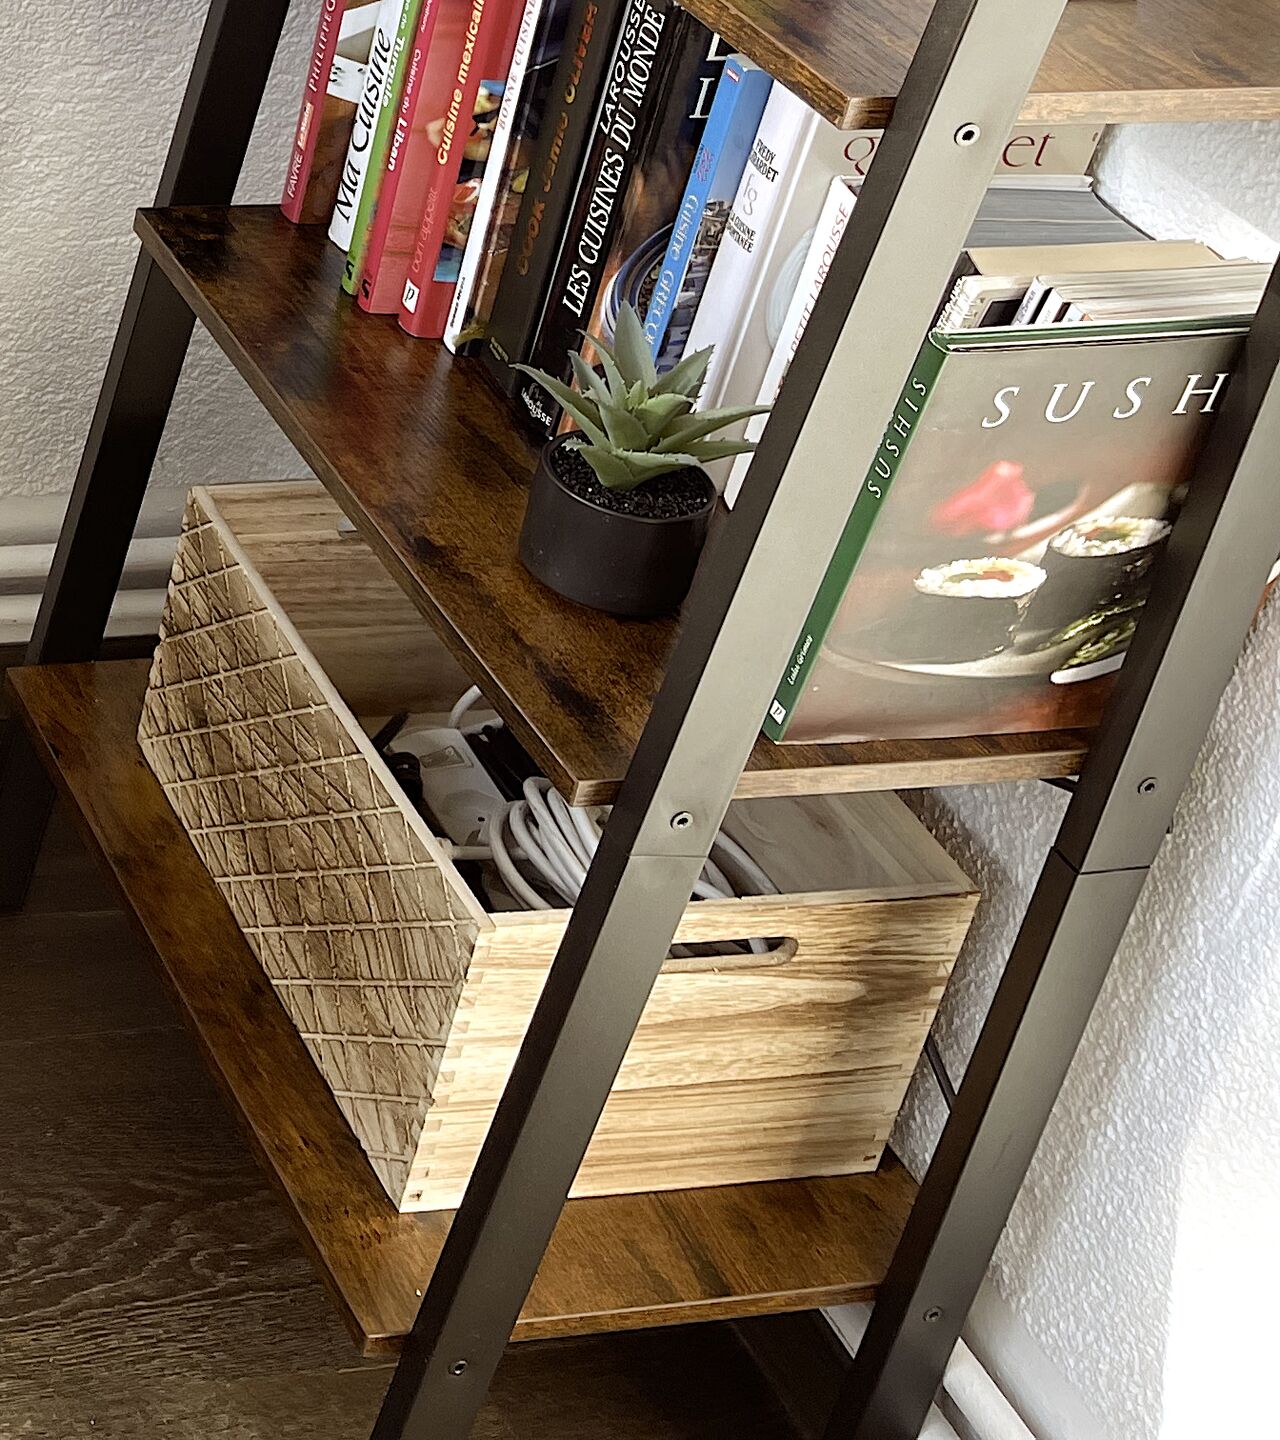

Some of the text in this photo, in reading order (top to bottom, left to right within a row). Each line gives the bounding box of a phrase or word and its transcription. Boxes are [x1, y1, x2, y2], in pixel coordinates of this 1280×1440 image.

[398, 12, 409, 31] de
[382, 36, 406, 108] Turquie
[387, 48, 422, 172] Cuisine du Liban
[498, 72, 518, 131] BONNE
[334, 28, 392, 223] Ma Cuisine
[437, 87, 463, 165] Cuisine
[562, 4, 666, 318] LES CUISINES DU MONDE
[287, 153, 304, 198] FAVRE
[809, 202, 849, 302] LAROUSSE
[867, 377, 928, 499] SUSHIS
[981, 373, 1230, 429] SUSH
